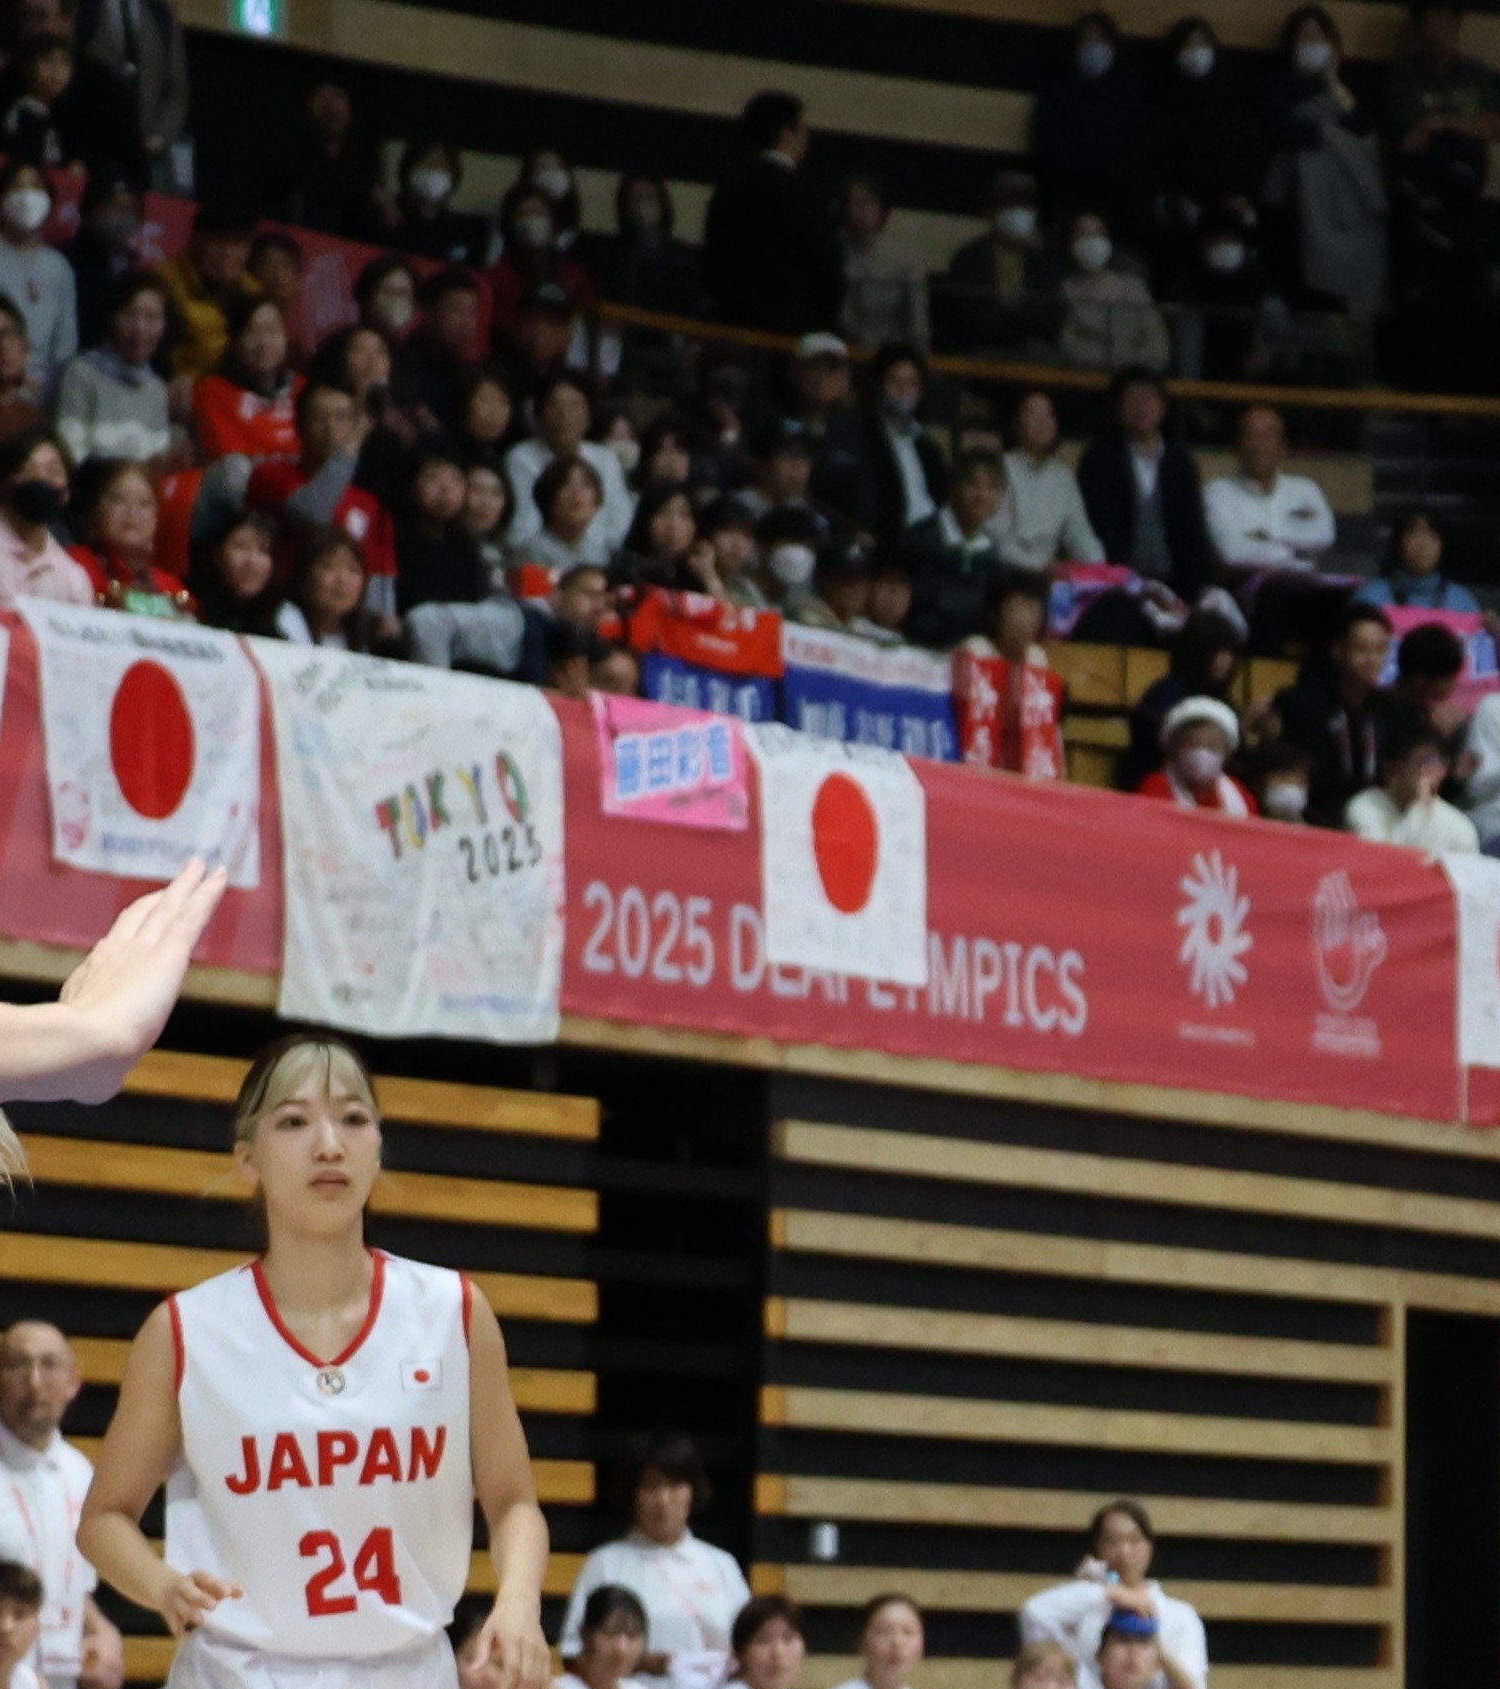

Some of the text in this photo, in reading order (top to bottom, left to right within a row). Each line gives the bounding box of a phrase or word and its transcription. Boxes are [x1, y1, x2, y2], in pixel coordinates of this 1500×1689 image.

[375, 750, 530, 860] TOKYO
[458, 823, 543, 884] 2025
[582, 880, 715, 988] 2025
[224, 1425, 448, 1496] JAPAN
[297, 1525, 404, 1618] 24
